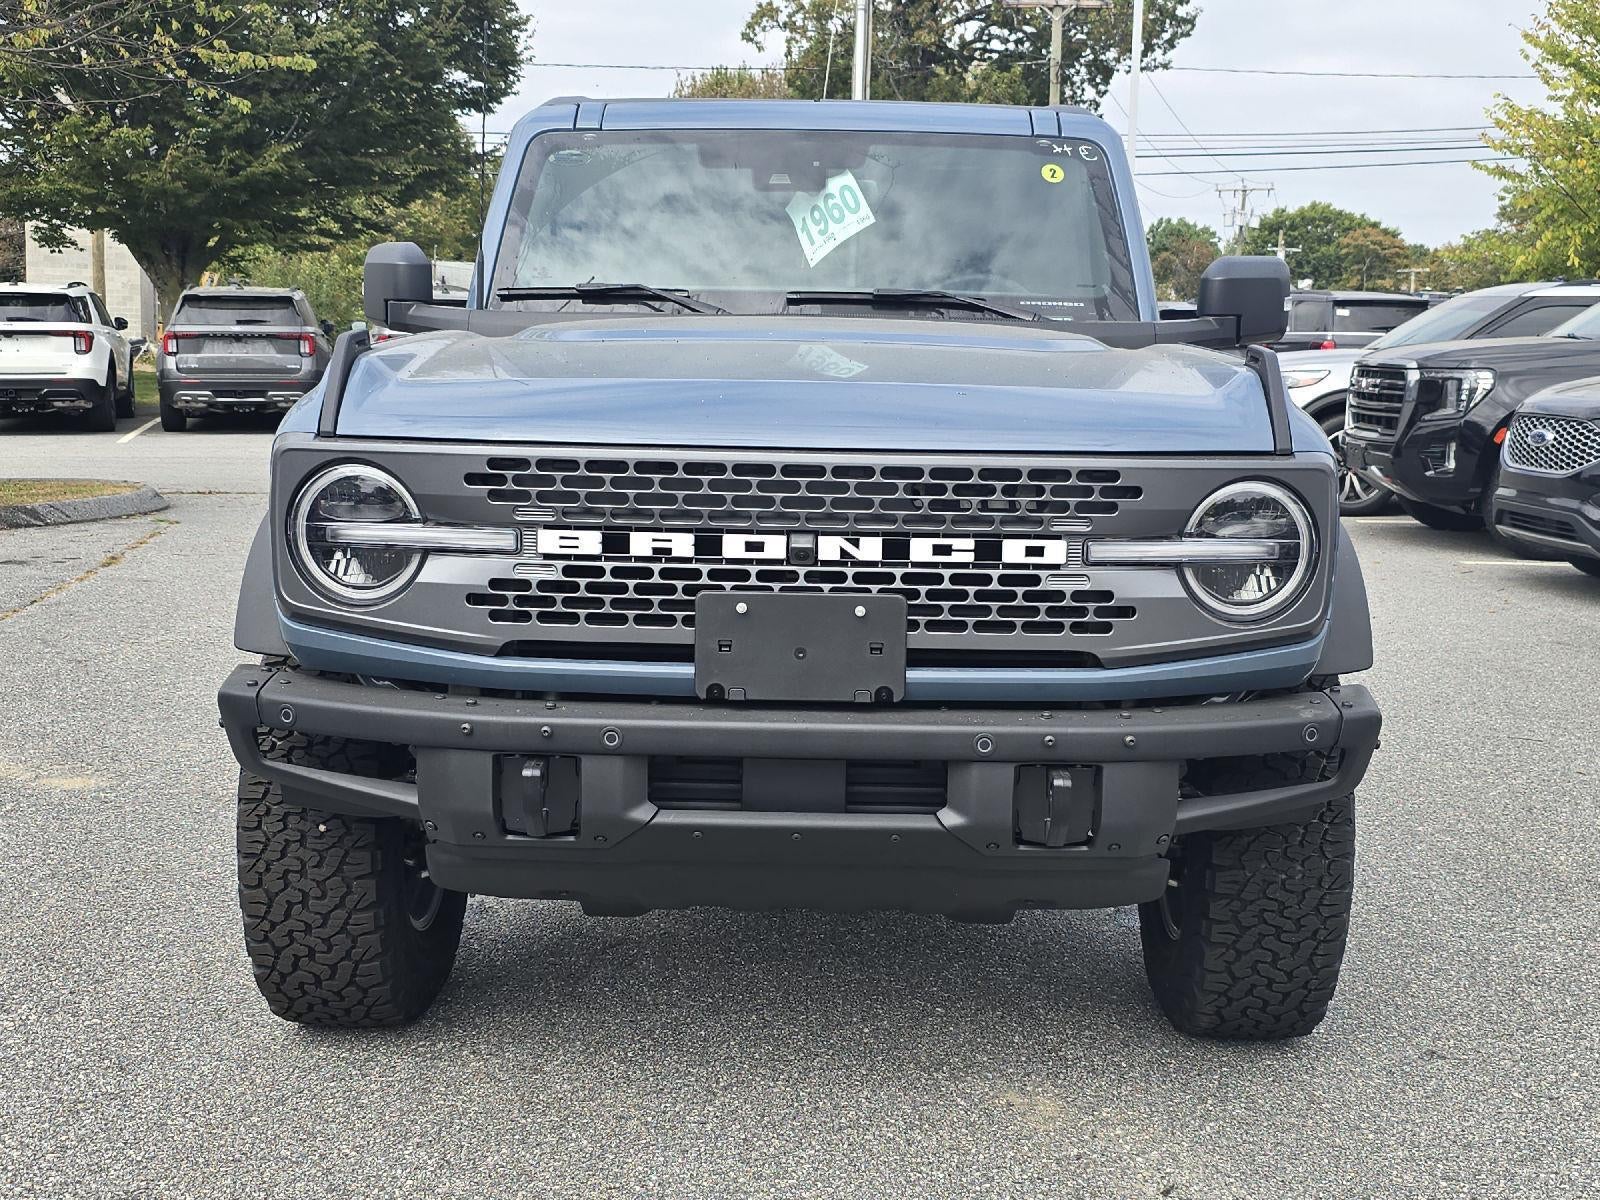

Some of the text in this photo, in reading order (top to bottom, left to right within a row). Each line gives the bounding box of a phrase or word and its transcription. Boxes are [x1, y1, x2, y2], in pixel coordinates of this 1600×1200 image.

[1049, 168, 1058, 179] 2
[800, 184, 861, 247] 1960
[537, 529, 1068, 564] BRONCO
